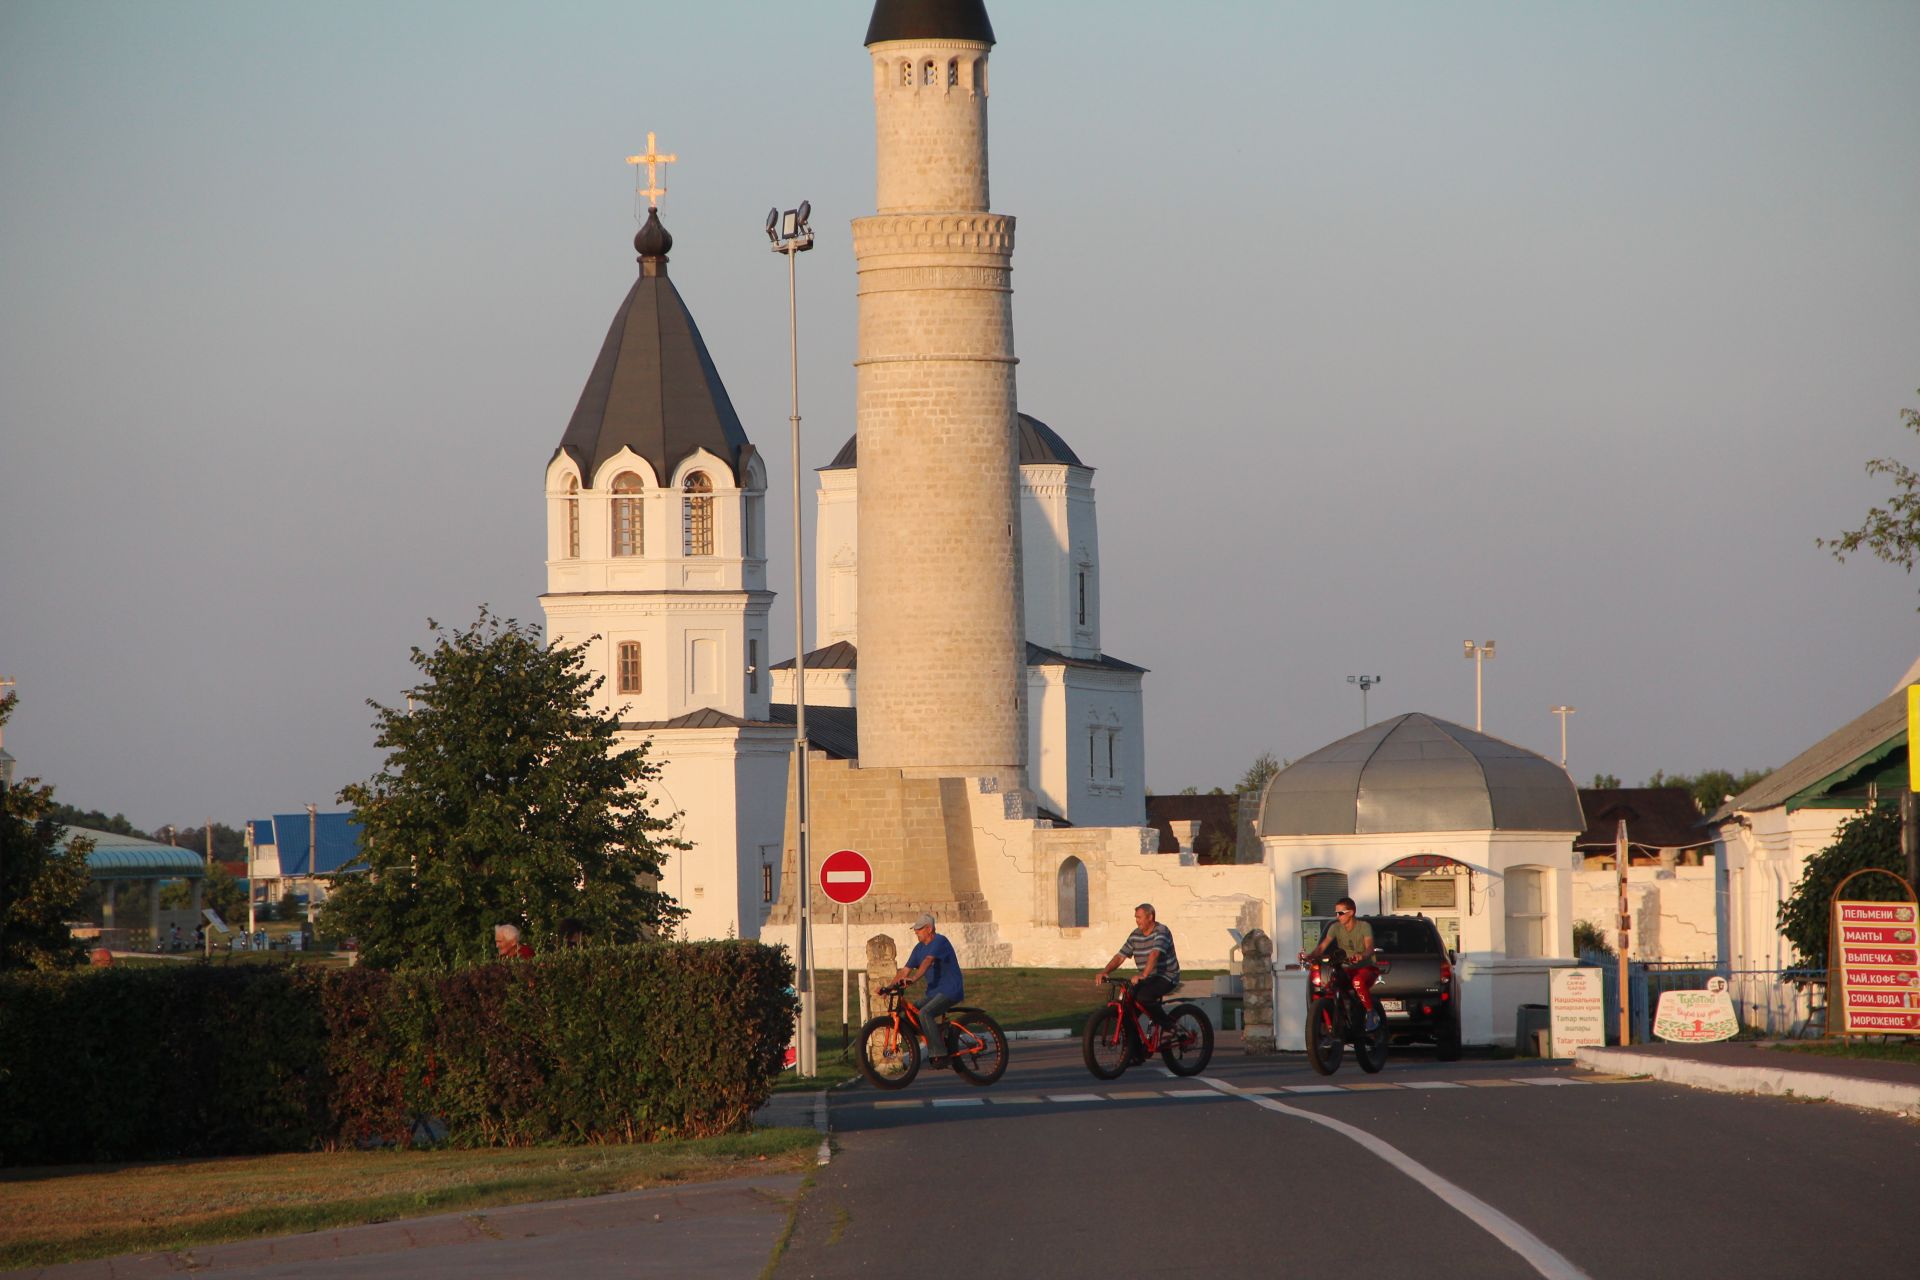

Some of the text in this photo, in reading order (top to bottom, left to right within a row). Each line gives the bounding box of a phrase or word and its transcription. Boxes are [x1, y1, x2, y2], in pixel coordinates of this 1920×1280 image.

[1844, 909, 1894, 919] ПЕЛЬМЕНИ
[1846, 931, 1883, 941] МАНТЫ
[1848, 953, 1894, 963] ВЫПЕЧКА
[1556, 1015, 1578, 1023] Татар
[1853, 1015, 1905, 1026] МОРОЖЕНОЕ
[1576, 1037, 1601, 1045] national
